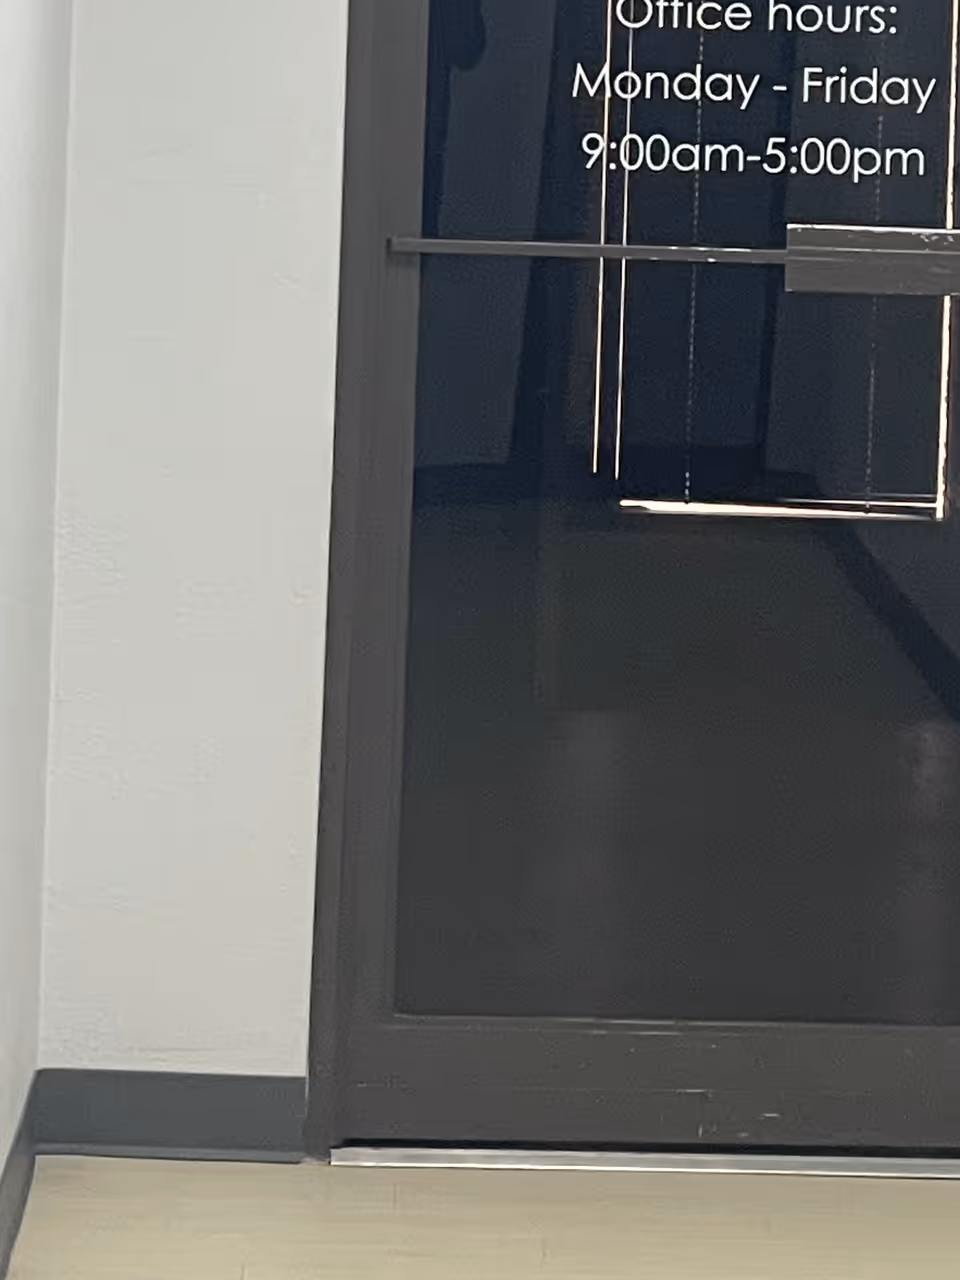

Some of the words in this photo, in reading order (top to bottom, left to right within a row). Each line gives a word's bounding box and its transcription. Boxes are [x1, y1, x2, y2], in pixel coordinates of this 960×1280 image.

[572, 62, 760, 110] Monday
[802, 66, 937, 114] Friday
[581, 132, 925, 184] 9:00am-5:00pm
